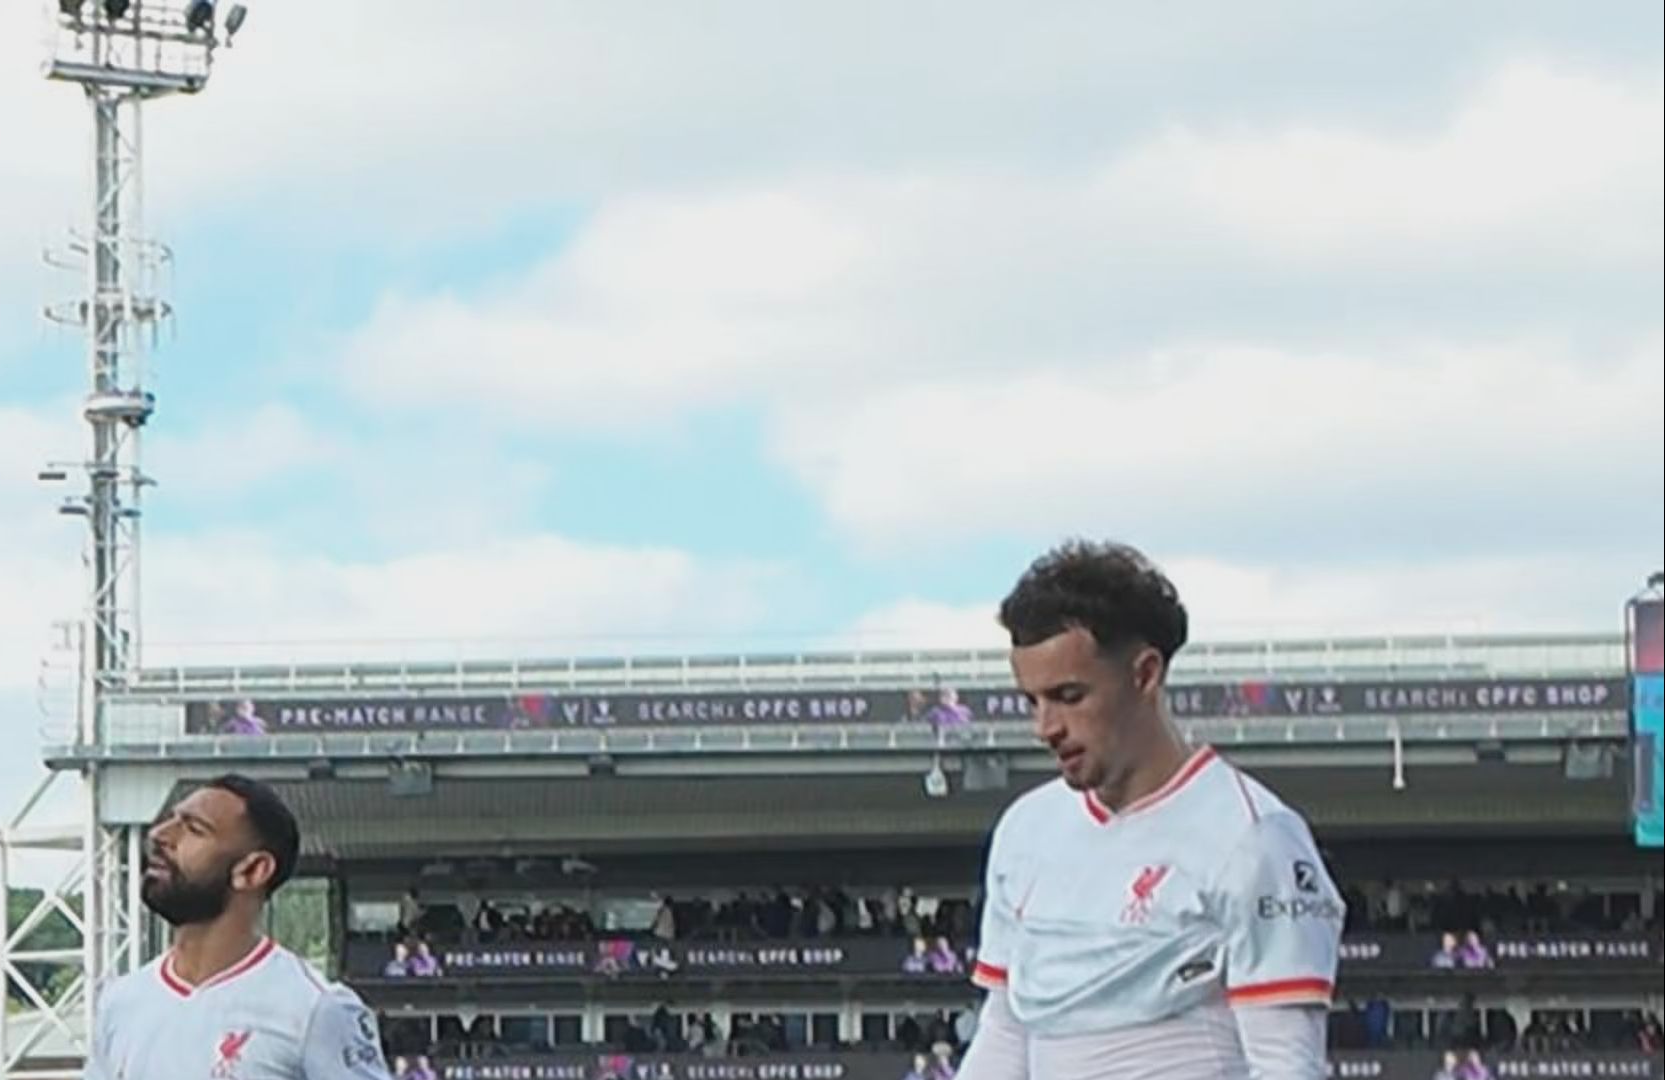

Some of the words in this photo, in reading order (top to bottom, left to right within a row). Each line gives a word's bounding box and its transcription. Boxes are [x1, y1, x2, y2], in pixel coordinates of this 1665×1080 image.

[1546, 685, 1608, 705] SHOP
[281, 707, 406, 725] PRE-MATCH
[743, 699, 800, 718] CPFC
[809, 698, 867, 716] SHOP
